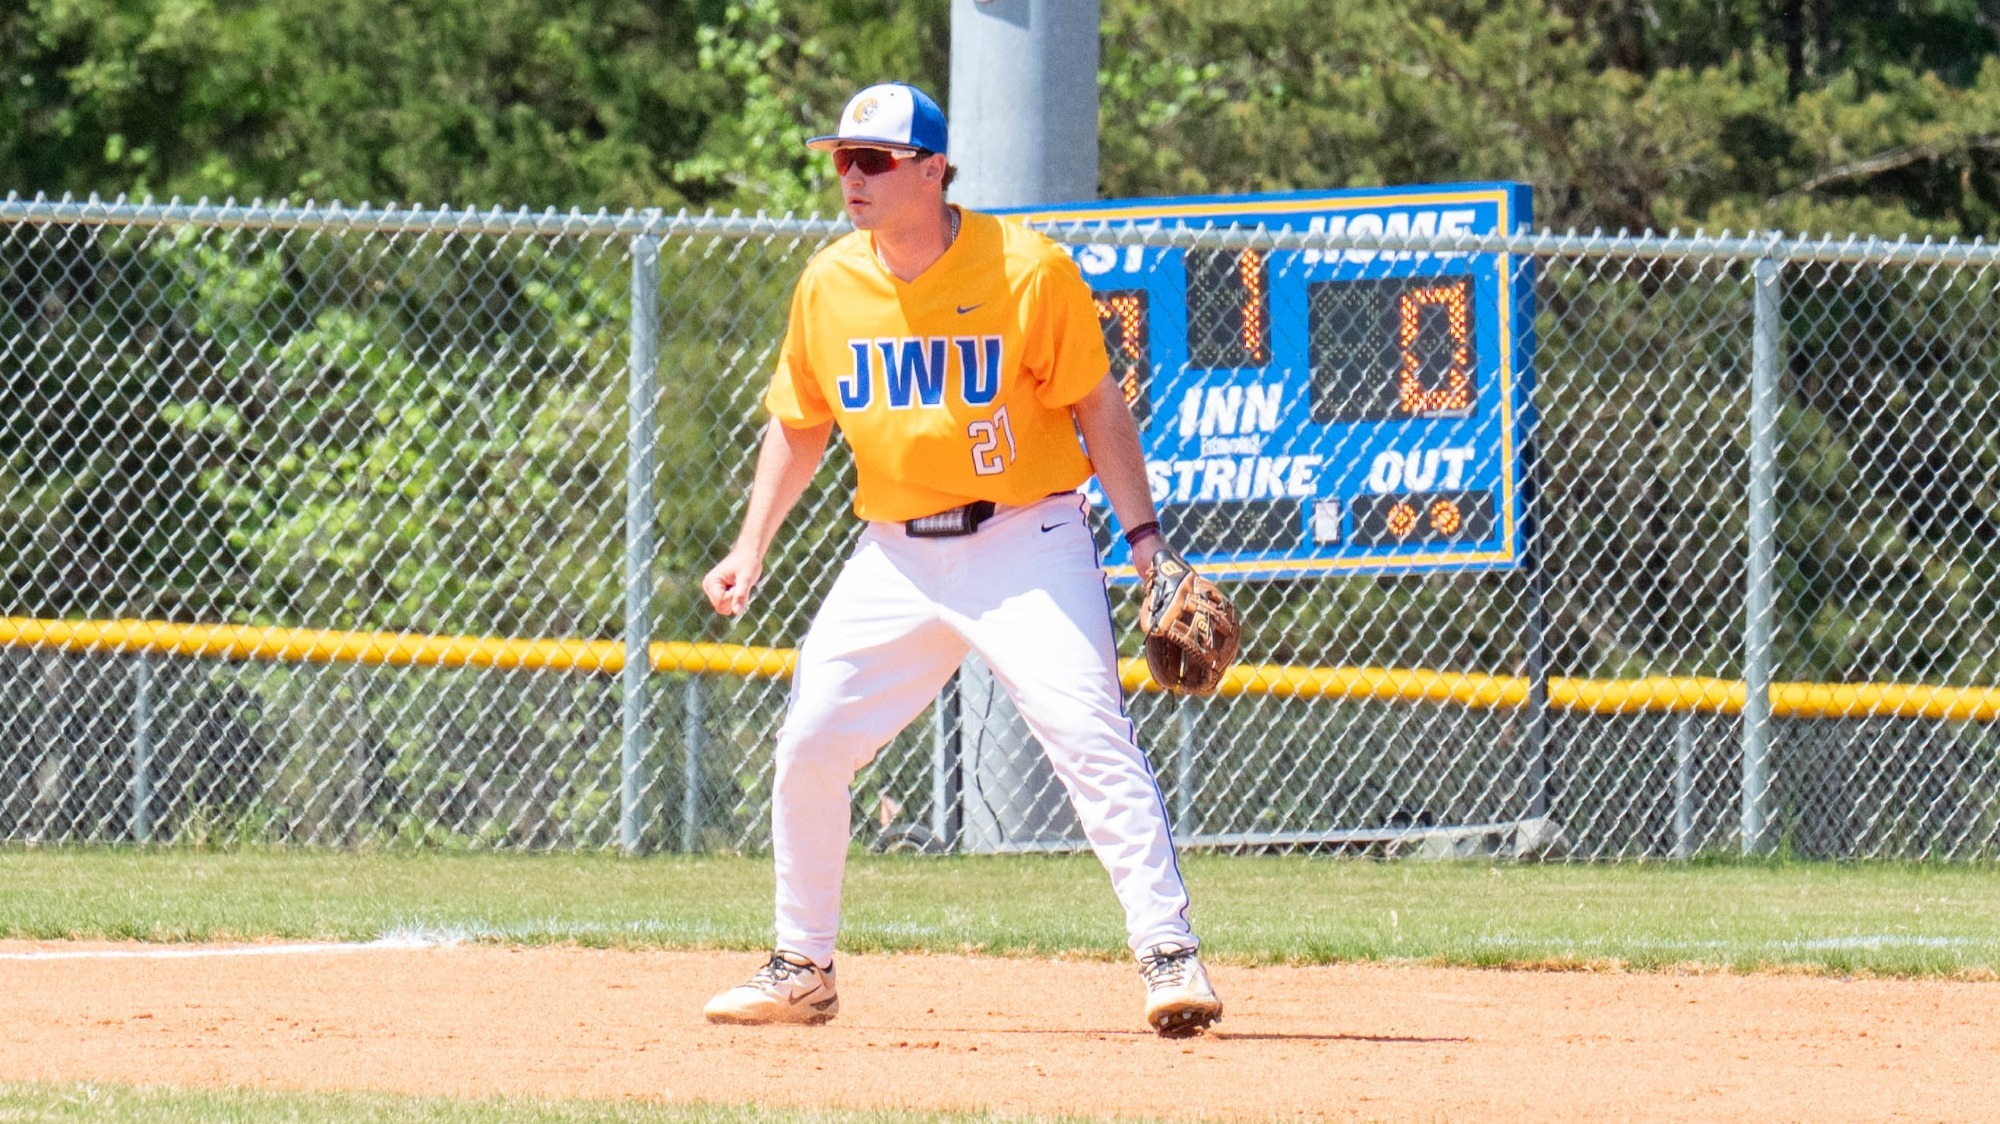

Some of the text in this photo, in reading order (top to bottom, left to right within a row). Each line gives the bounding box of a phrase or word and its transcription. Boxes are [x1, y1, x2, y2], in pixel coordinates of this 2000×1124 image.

[1303, 210, 1475, 264] HOME
[836, 334, 1002, 412] JWU
[1400, 282, 1468, 412] 0
[1179, 384, 1284, 437] INN
[968, 403, 1016, 477] 27
[1145, 454, 1323, 503] STRIKE
[1369, 447, 1475, 494] OUT
